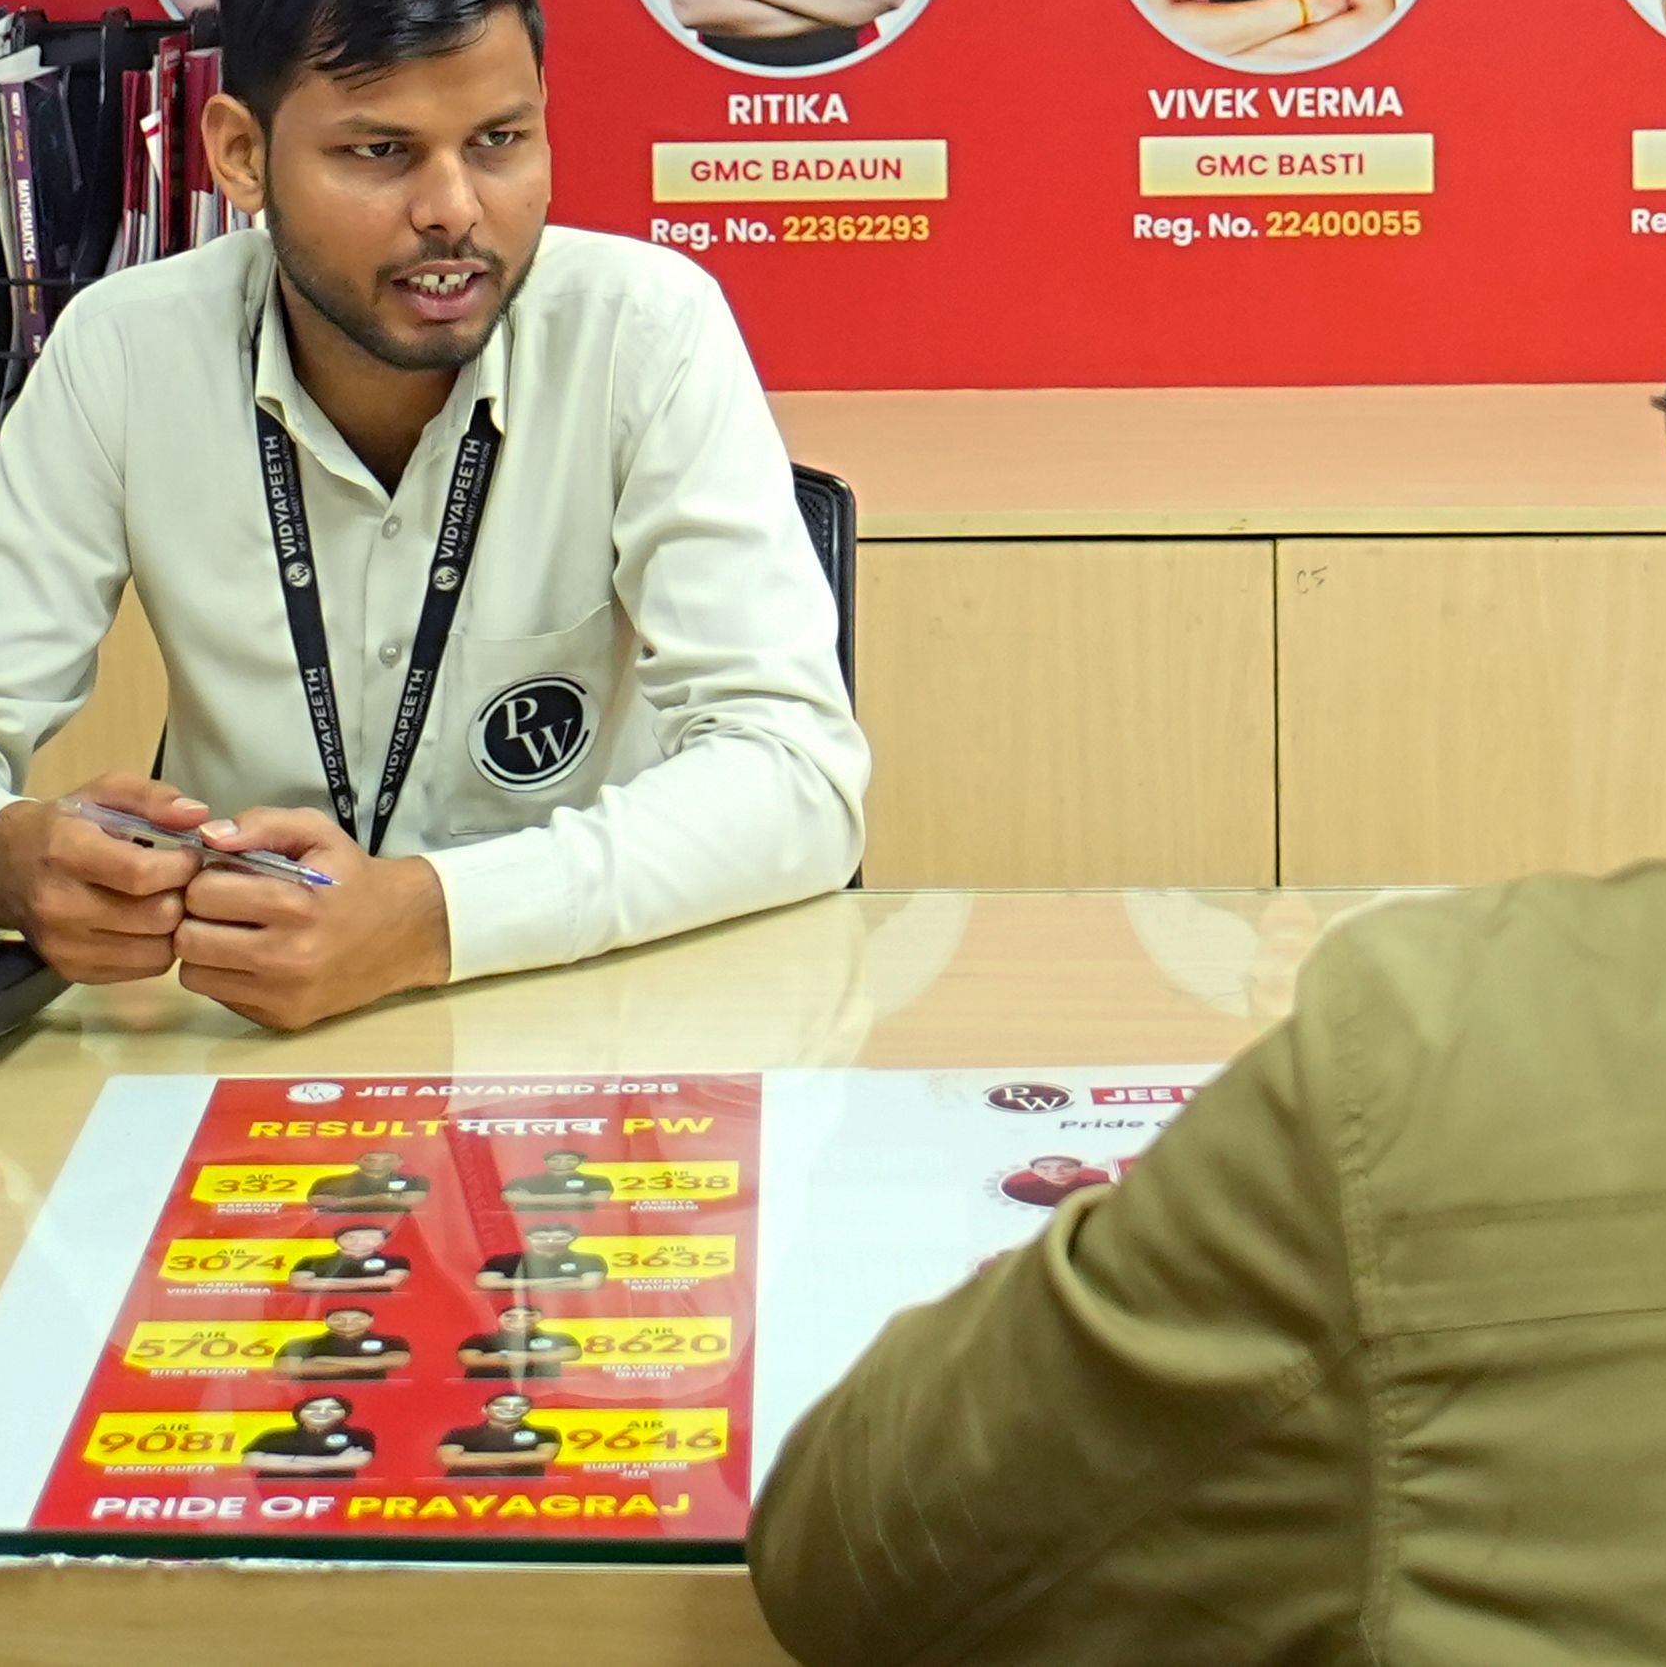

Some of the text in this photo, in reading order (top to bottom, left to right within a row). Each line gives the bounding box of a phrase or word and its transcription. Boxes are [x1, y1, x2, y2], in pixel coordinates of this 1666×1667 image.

[729, 94, 848, 124] RITIKA
[1149, 87, 1403, 119] VIVEK VERMA
[691, 159, 901, 182] GMC BADAUN
[1197, 154, 1363, 176] GMC BASTI
[17, 179, 36, 262] MATHEMATICS
[1134, 210, 1421, 246] Reg. No. 22400055
[651, 215, 929, 251] Reg. No. 22362293
[263, 435, 298, 559] VIDYAPEETH
[437, 438, 481, 559] VIDYAPEETH
[305, 668, 342, 787] VIDYAPEETH
[382, 668, 426, 786] VIDYAPEETH
[503, 696, 574, 769] PW
[356, 1086, 408, 1097] JEE
[414, 1083, 595, 1096] ADVANCED
[1004, 1088, 1059, 1111] PW
[1103, 1089, 1173, 1101] JEE
[249, 1116, 714, 1137] RESULT मतलब PW
[1060, 1119, 1144, 1129] Pride
[213, 1180, 297, 1193] 332
[620, 1176, 730, 1190] 2338
[168, 1255, 287, 1270] 3074
[611, 1252, 730, 1267] 3635
[133, 1339, 275, 1358] 5706
[583, 1335, 727, 1354] 8620
[99, 1432, 237, 1453] 9081
[566, 1428, 722, 1450] 9646
[90, 1493, 690, 1520] PRIDE OF PRAYAGRAJ
